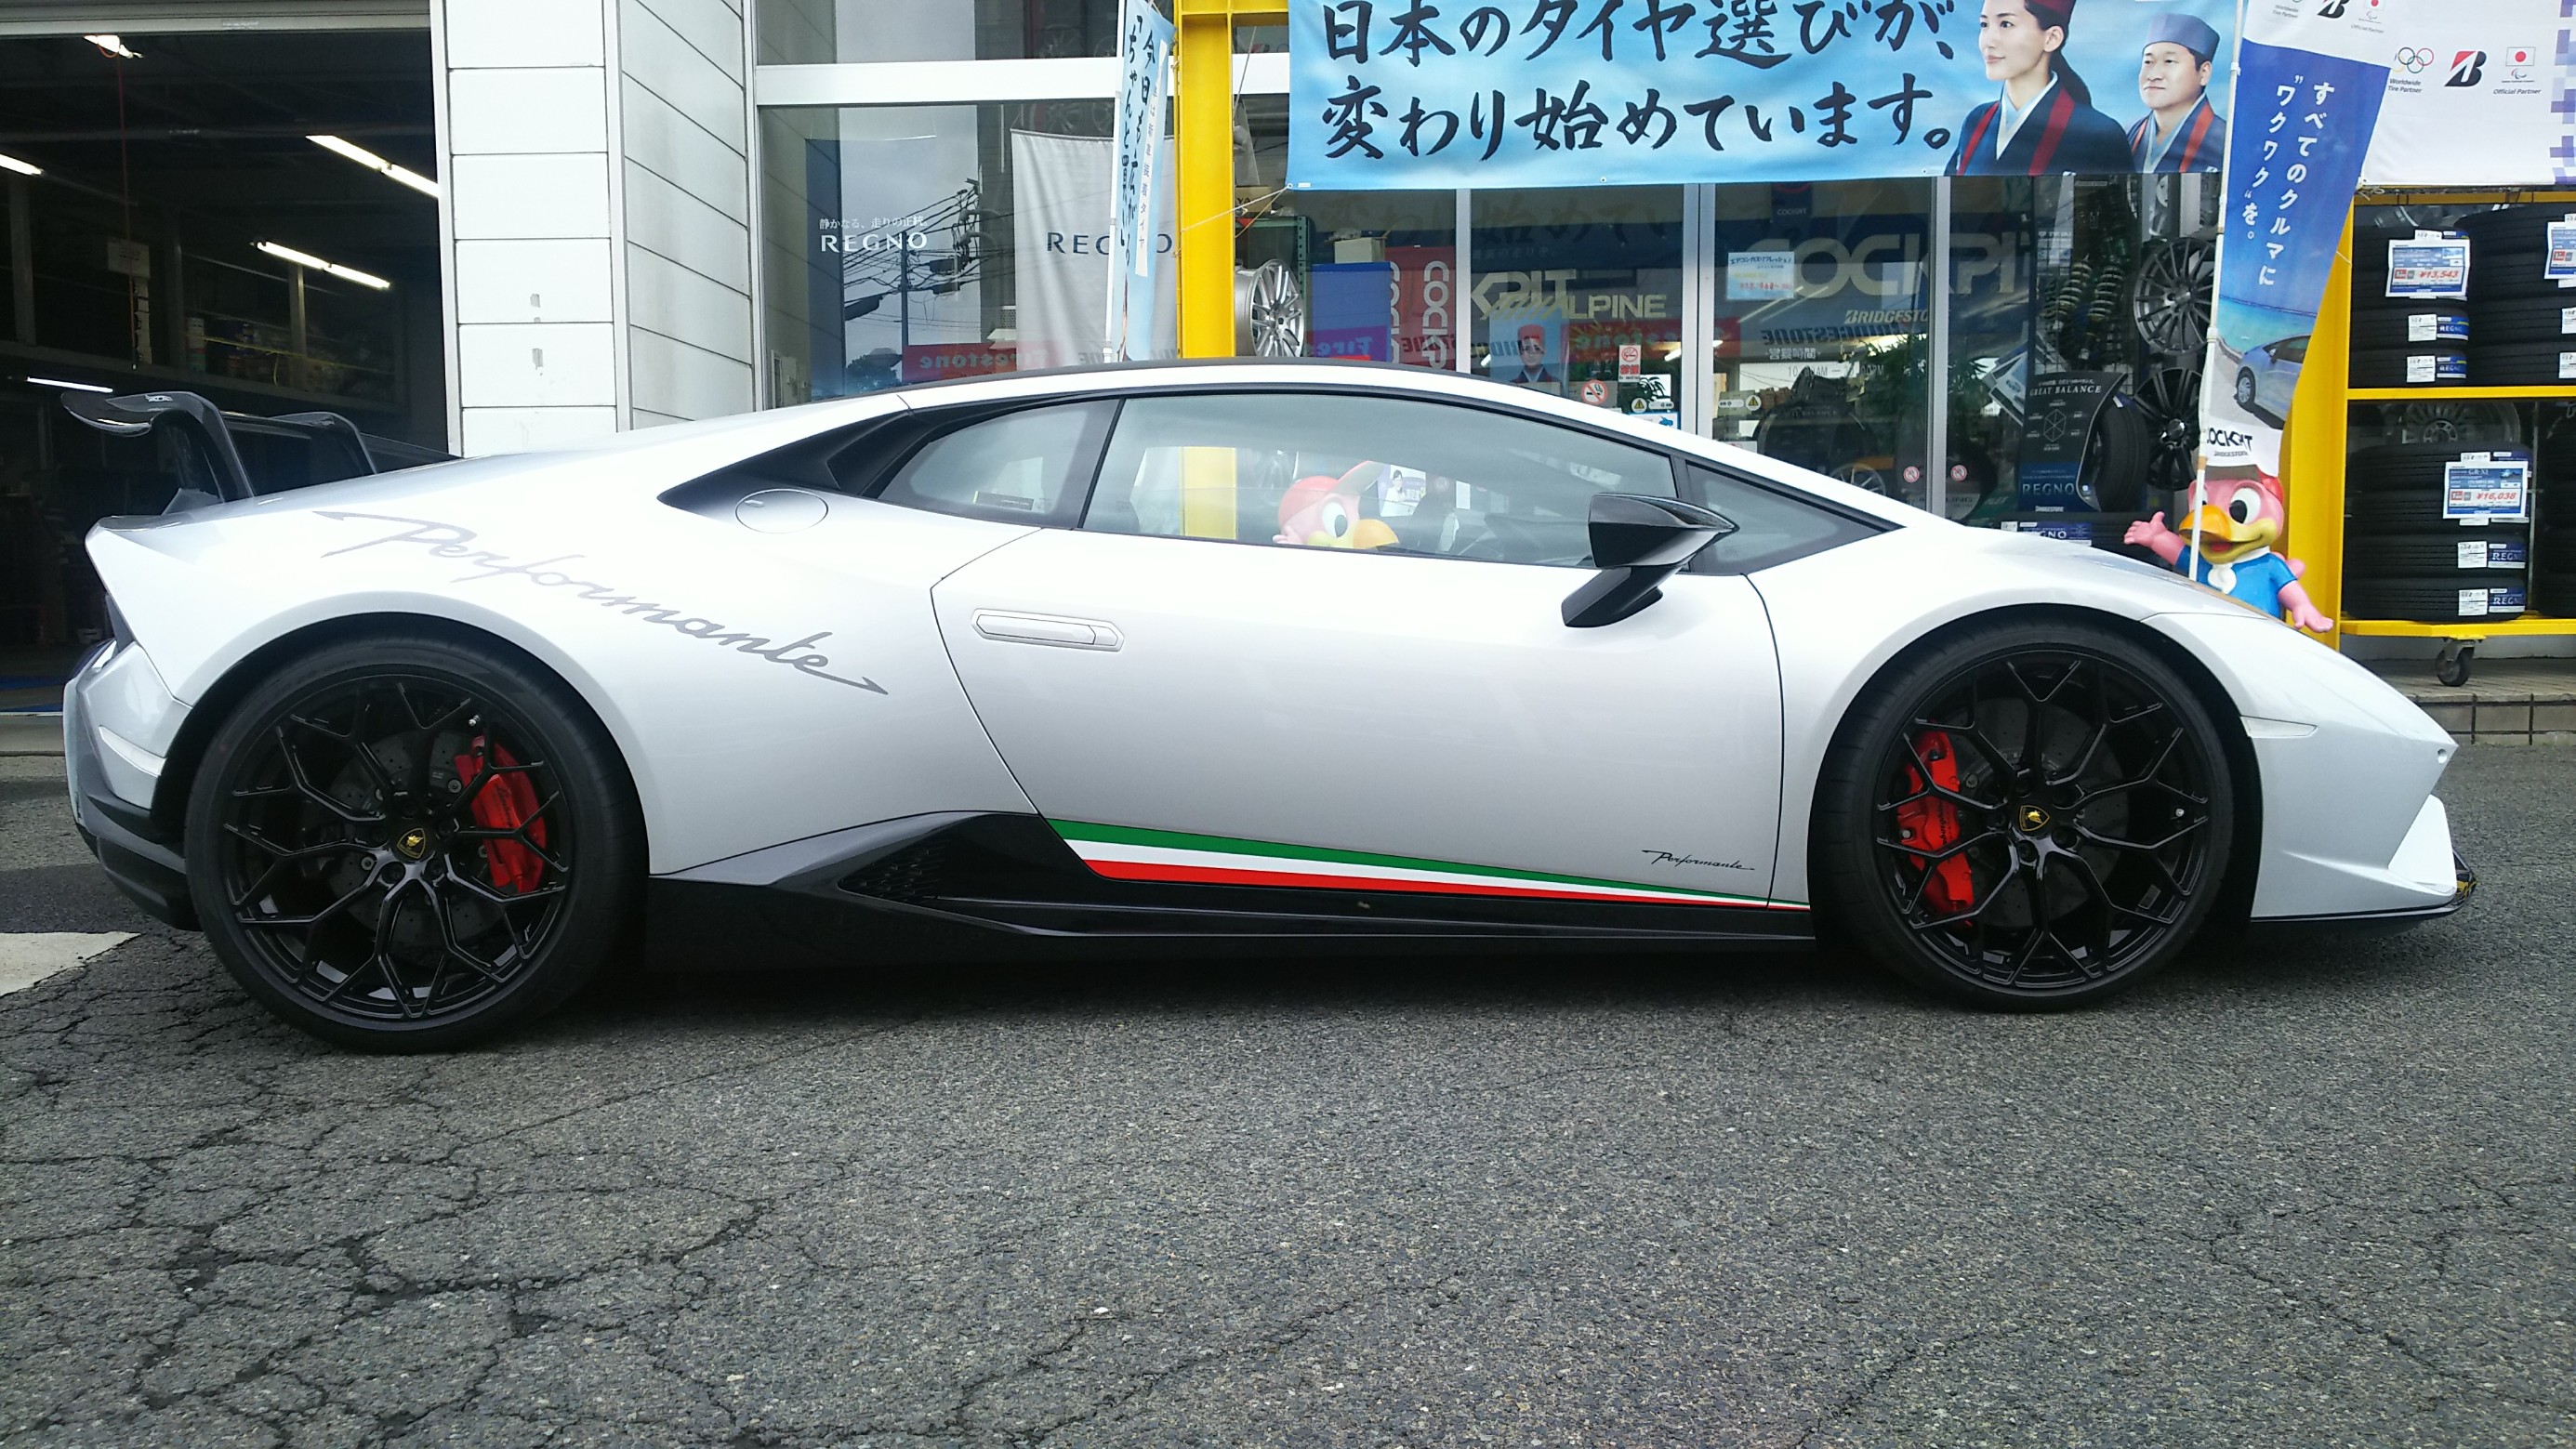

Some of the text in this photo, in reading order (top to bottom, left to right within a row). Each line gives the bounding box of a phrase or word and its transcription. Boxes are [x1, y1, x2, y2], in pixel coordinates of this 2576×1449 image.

[1324, 0, 1954, 69] 日本のタイヤ選びが、
[1322, 72, 1950, 161] 変わり始めています。
[2259, 82, 2335, 286] すべてのクルマに
[821, 232, 928, 253] REGNO
[1047, 232, 1173, 255] REGO
[2419, 270, 2459, 279] ¥13,543
[2055, 385, 2102, 395] BALANCE
[2022, 482, 2075, 495] REGNO
[2477, 492, 2517, 500] ¥16,038
[311, 510, 889, 695] Performante
[1642, 850, 1756, 871] Performante
